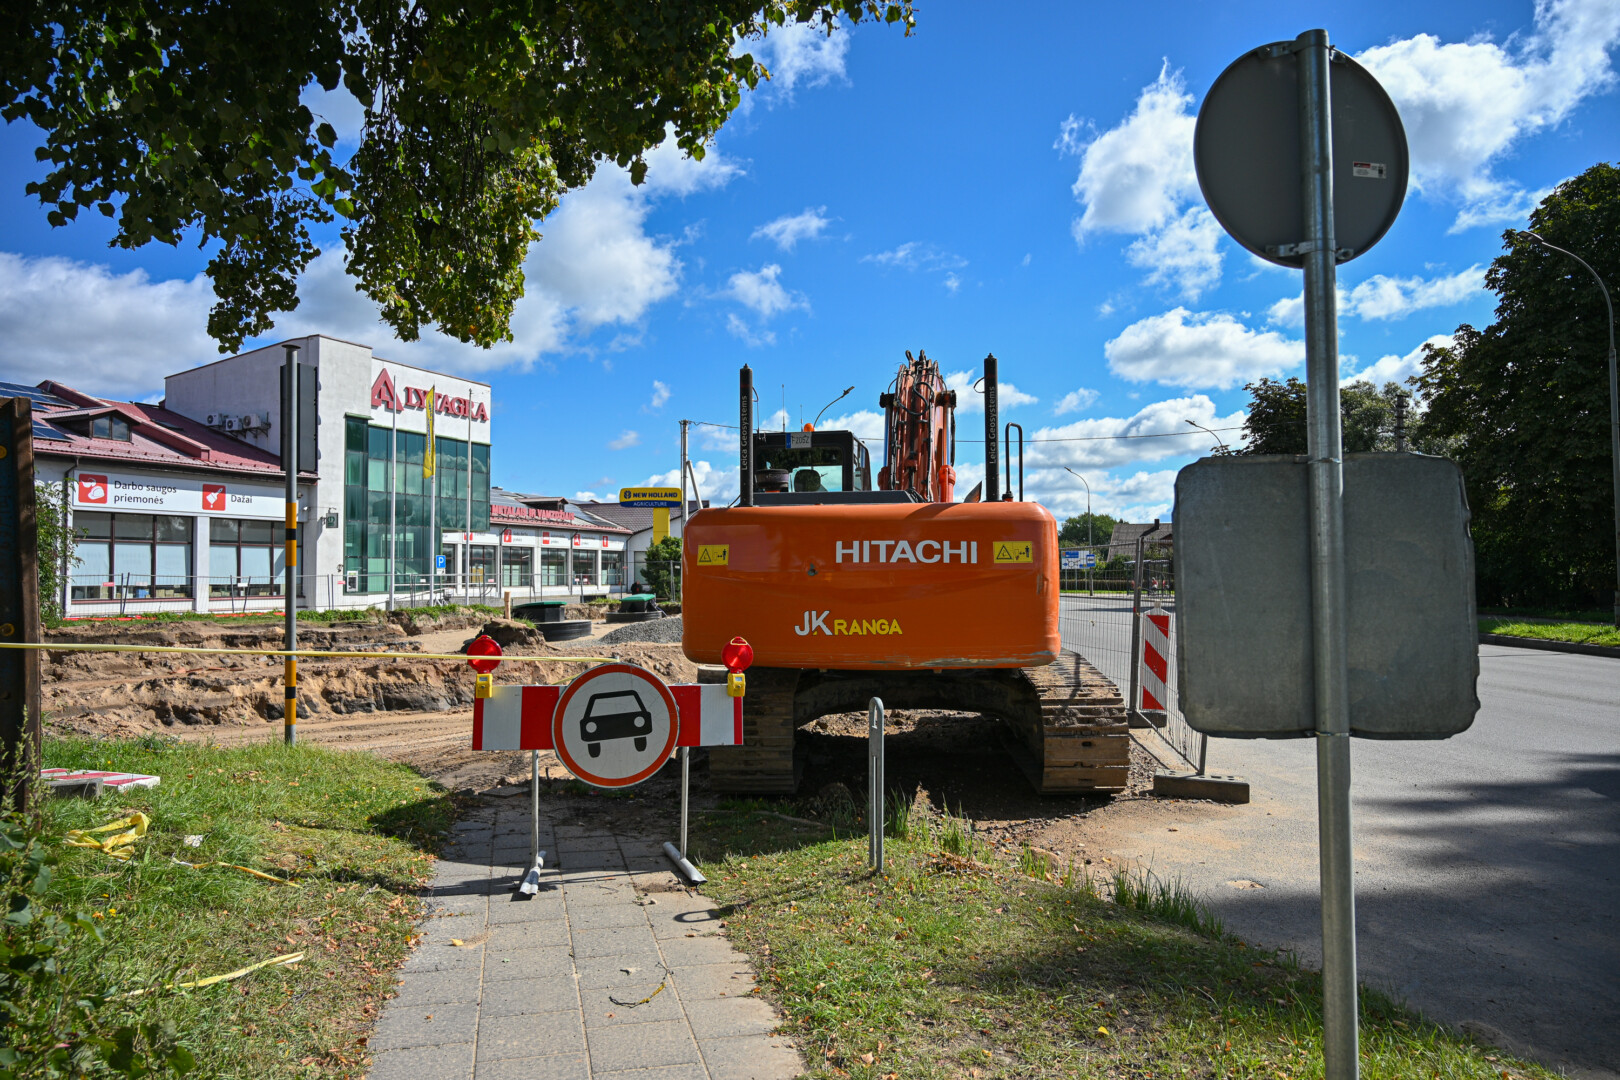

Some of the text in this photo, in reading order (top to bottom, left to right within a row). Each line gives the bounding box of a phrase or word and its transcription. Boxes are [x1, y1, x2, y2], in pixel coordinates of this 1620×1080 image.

[741, 395, 749, 446] Geosystems
[989, 386, 997, 439] Geosystems
[114, 480, 177, 495] Darbo saugos
[114, 493, 164, 504] priemonės
[230, 494, 253, 504] Dažai
[836, 540, 977, 564] HITACHI
[438, 557, 444, 567] P
[795, 610, 903, 636] JK RANGA
